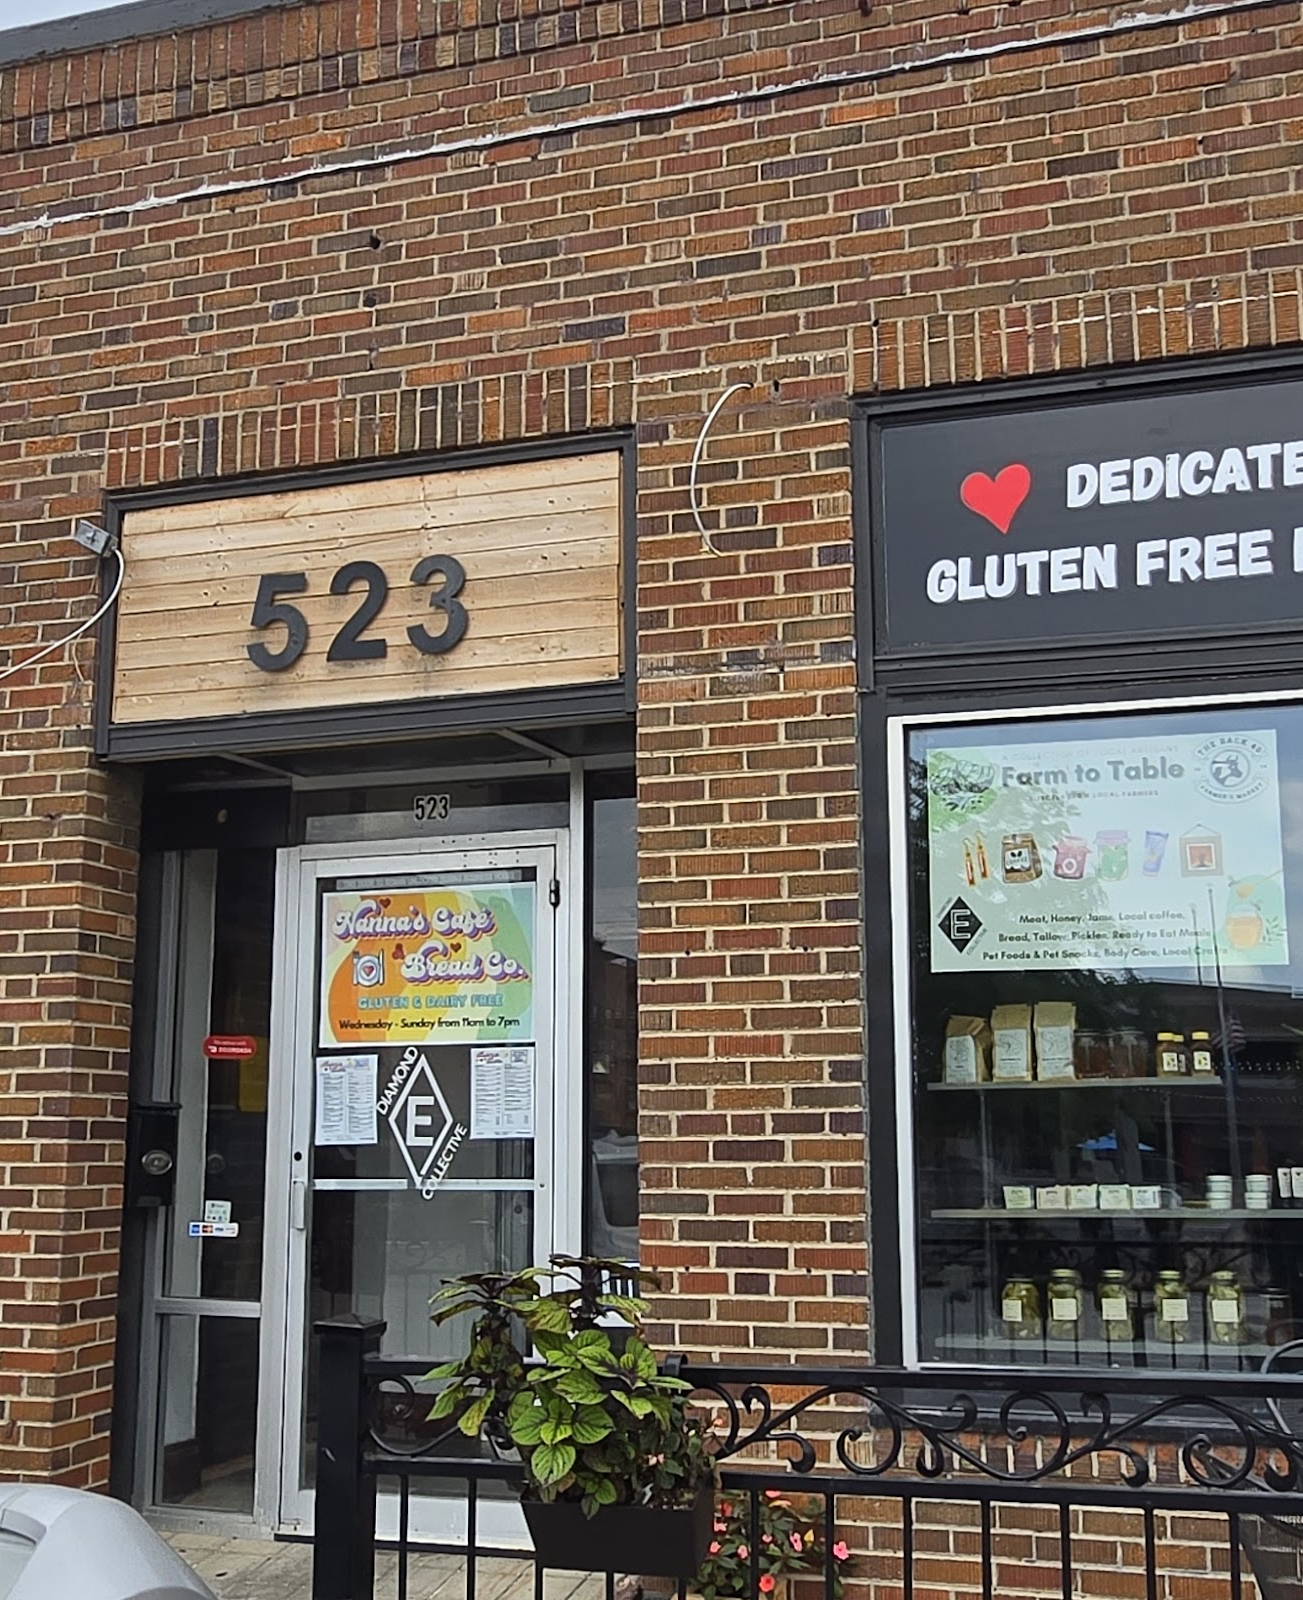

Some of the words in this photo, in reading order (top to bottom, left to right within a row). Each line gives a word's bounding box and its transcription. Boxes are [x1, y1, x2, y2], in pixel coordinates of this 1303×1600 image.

[926, 544, 1117, 604] GLUTEN
[1137, 529, 1274, 586] FREE
[247, 554, 469, 671] 523
[1002, 766, 1067, 787] Farm
[1075, 764, 1101, 783] to
[1106, 756, 1185, 782] Table
[415, 794, 450, 821] 523
[332, 899, 431, 941] Nanna's
[431, 907, 496, 938] Café
[950, 909, 971, 940] E
[1119, 911, 1146, 920] Local
[998, 933, 1030, 943] Bread,
[1113, 930, 1144, 940] Ready
[1147, 930, 1157, 938] to
[1160, 930, 1176, 938] Eat
[401, 940, 483, 983] Bread
[484, 951, 530, 982] Co.
[983, 951, 998, 960] Pet
[1001, 950, 1031, 959] Foods
[1033, 950, 1041, 959] &
[1043, 950, 1059, 959] Pet
[1104, 948, 1129, 959] Body
[1162, 946, 1191, 956] Local
[358, 996, 409, 1010] GLUTEN
[426, 994, 467, 1009] DAIRY
[470, 993, 503, 1007] FREE
[339, 1018, 393, 1031] Wednesday
[400, 1017, 436, 1030] Sunday
[437, 1017, 460, 1028] from
[486, 1018, 496, 1027] to
[498, 1016, 520, 1028] 7pm
[376, 1046, 419, 1116] DIAMOND
[406, 1096, 434, 1146] E
[421, 1122, 468, 1201] COLLECTIVE
